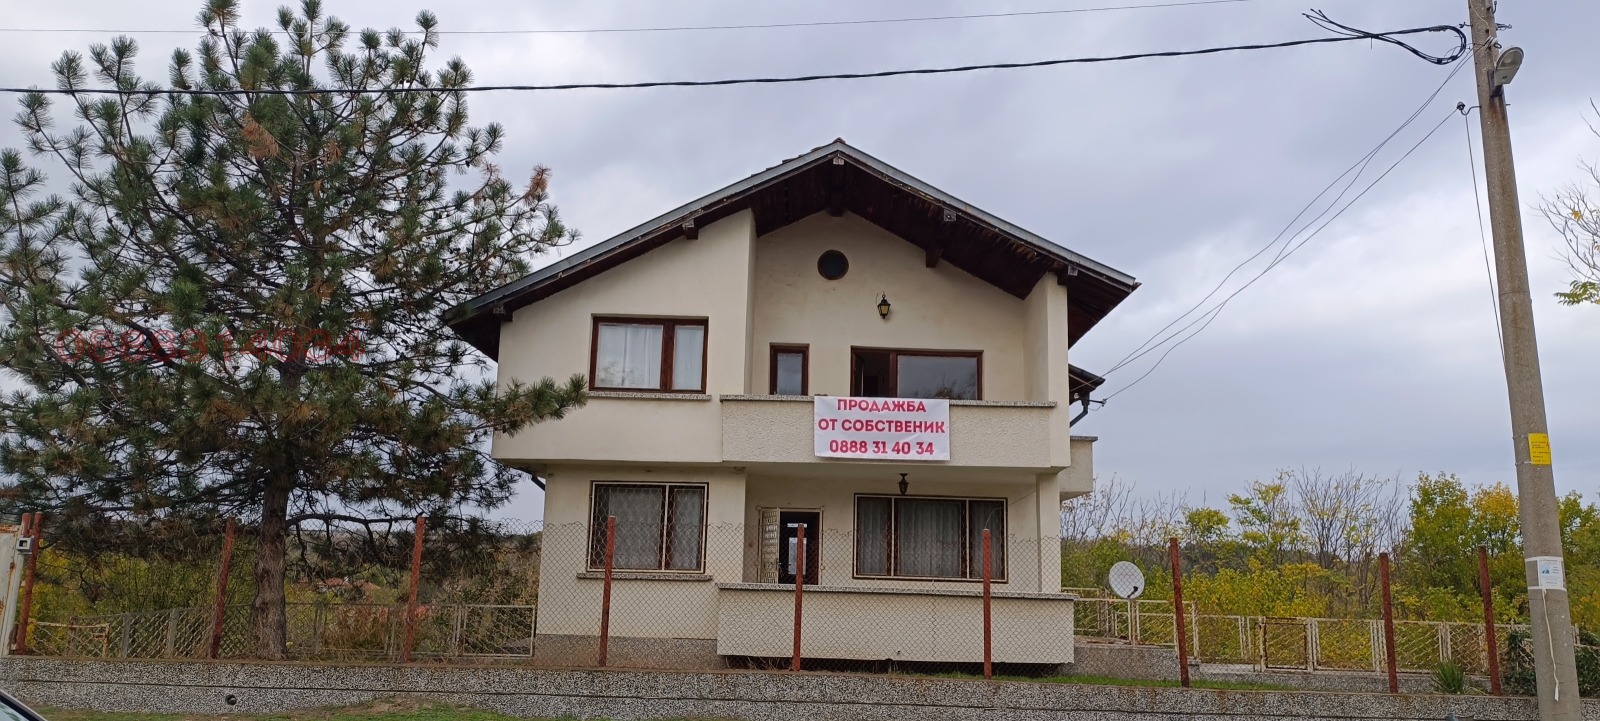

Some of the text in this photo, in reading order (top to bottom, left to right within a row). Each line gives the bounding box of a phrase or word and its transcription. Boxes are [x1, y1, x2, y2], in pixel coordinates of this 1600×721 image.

[837, 398, 927, 413] ПРОДАЖБА
[818, 418, 946, 434] ОТ СОБСТВЕНИК
[829, 440, 934, 455] 0888 31 40 34
